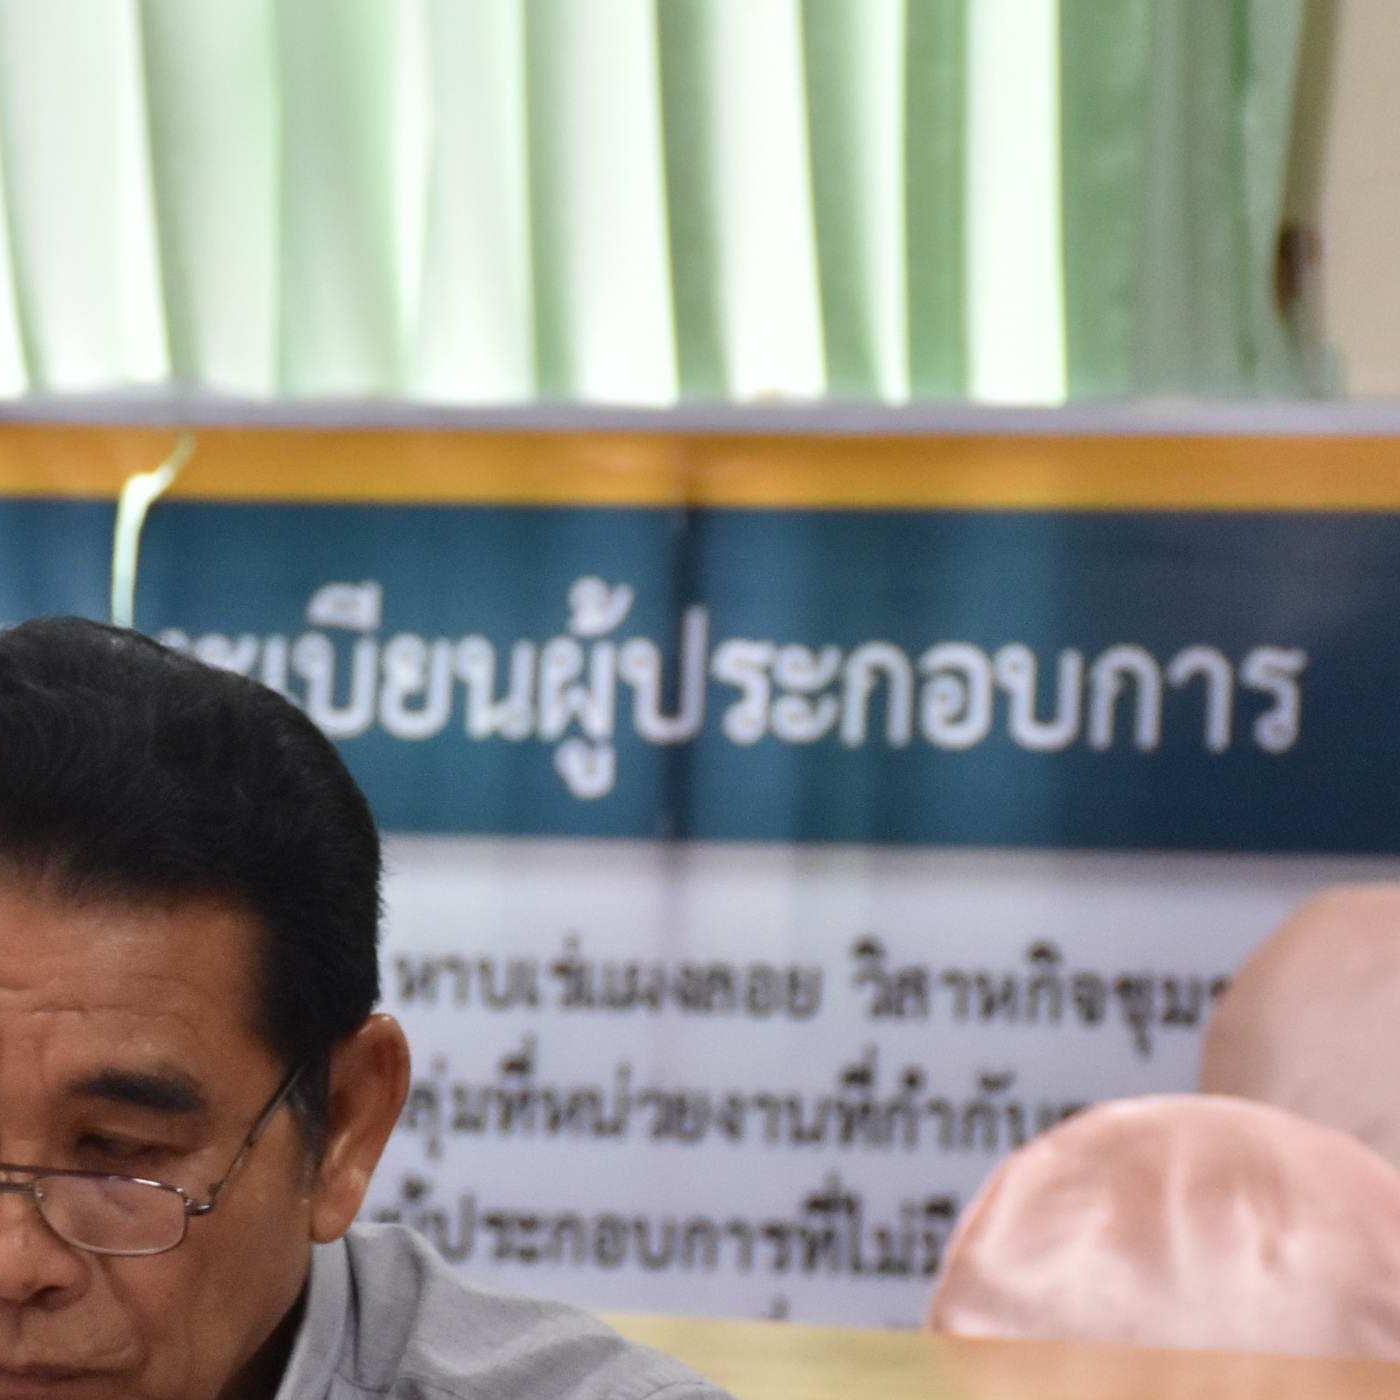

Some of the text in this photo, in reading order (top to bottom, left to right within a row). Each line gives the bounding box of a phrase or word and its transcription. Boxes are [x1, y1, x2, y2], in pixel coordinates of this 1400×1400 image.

[163, 574, 1308, 802] เบียนผู้ประกอบการ
[400, 1034, 1084, 1162] ลุ่มที่หน่วยงานที่กำกับ
